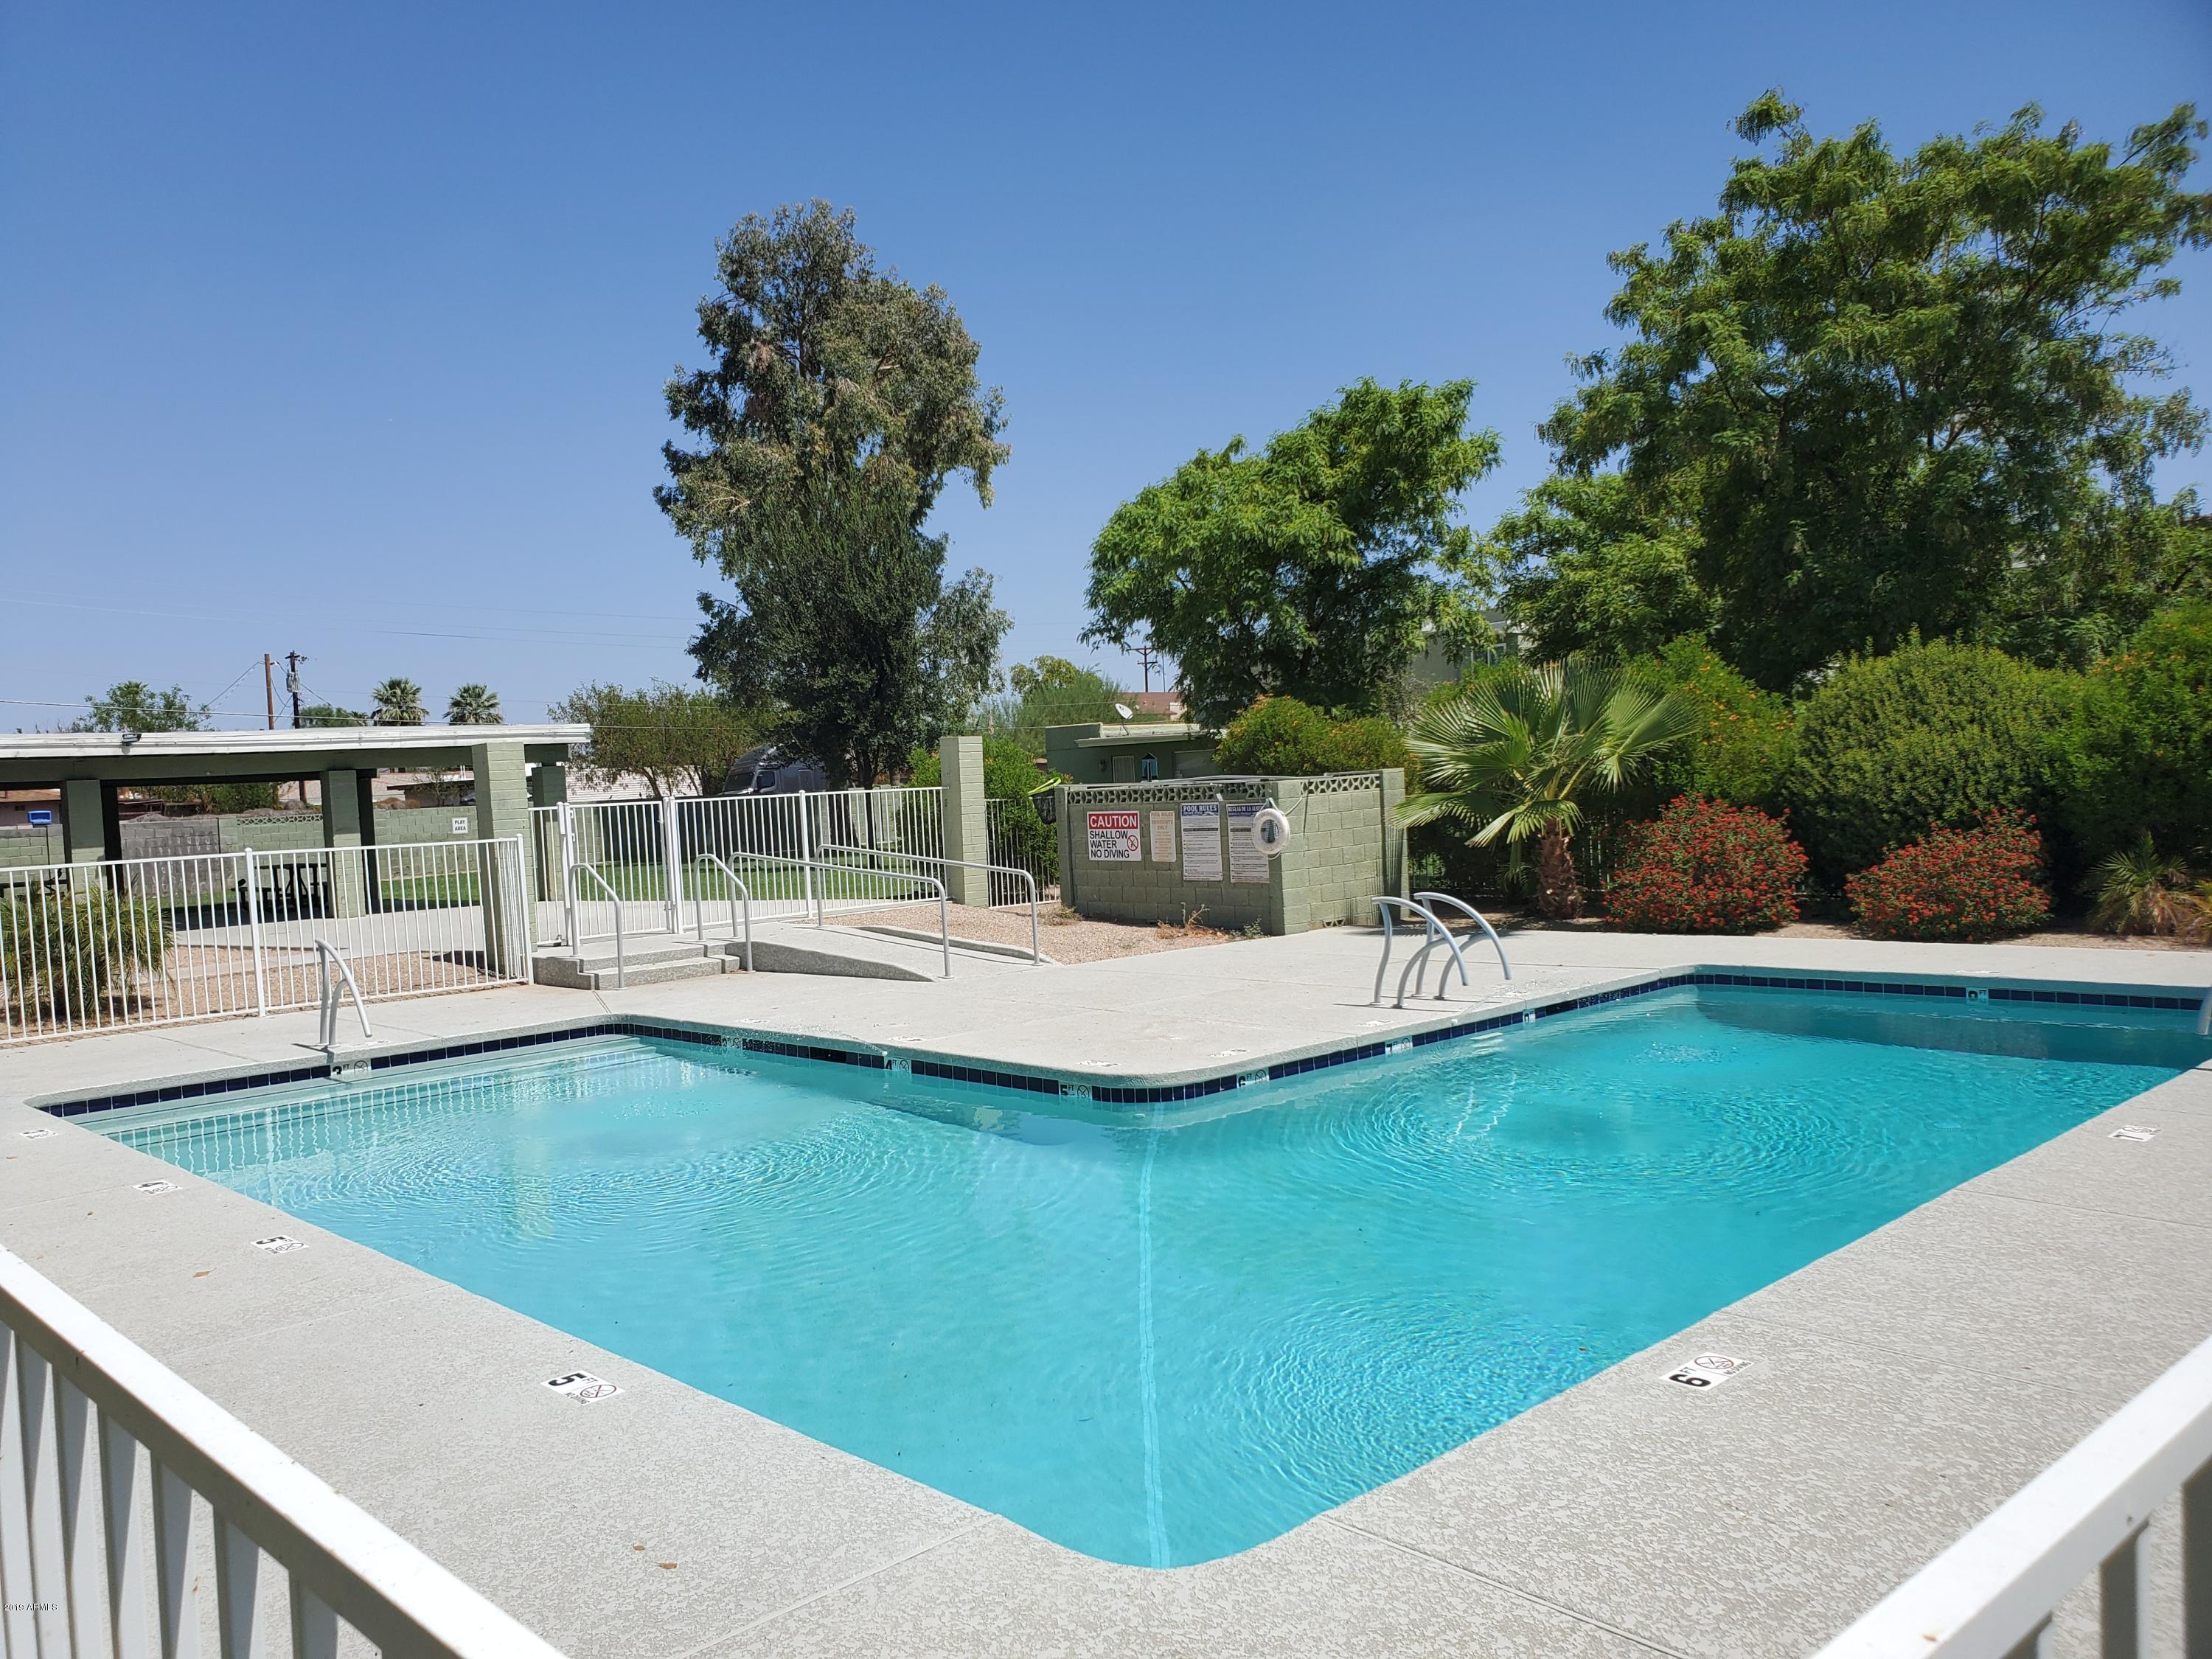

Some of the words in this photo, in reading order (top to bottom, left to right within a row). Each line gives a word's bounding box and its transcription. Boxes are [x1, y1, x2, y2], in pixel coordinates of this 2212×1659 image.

[1090, 815, 1137, 827] CAUTION
[1090, 830, 1128, 839] SHALLOW
[1090, 840, 1117, 849] WATER
[1091, 849, 1102, 858] NO
[1106, 849, 1130, 858] DIVING
[1060, 1084, 1068, 1096] 5
[255, 1236, 287, 1245] 5
[548, 1372, 588, 1387] 5
